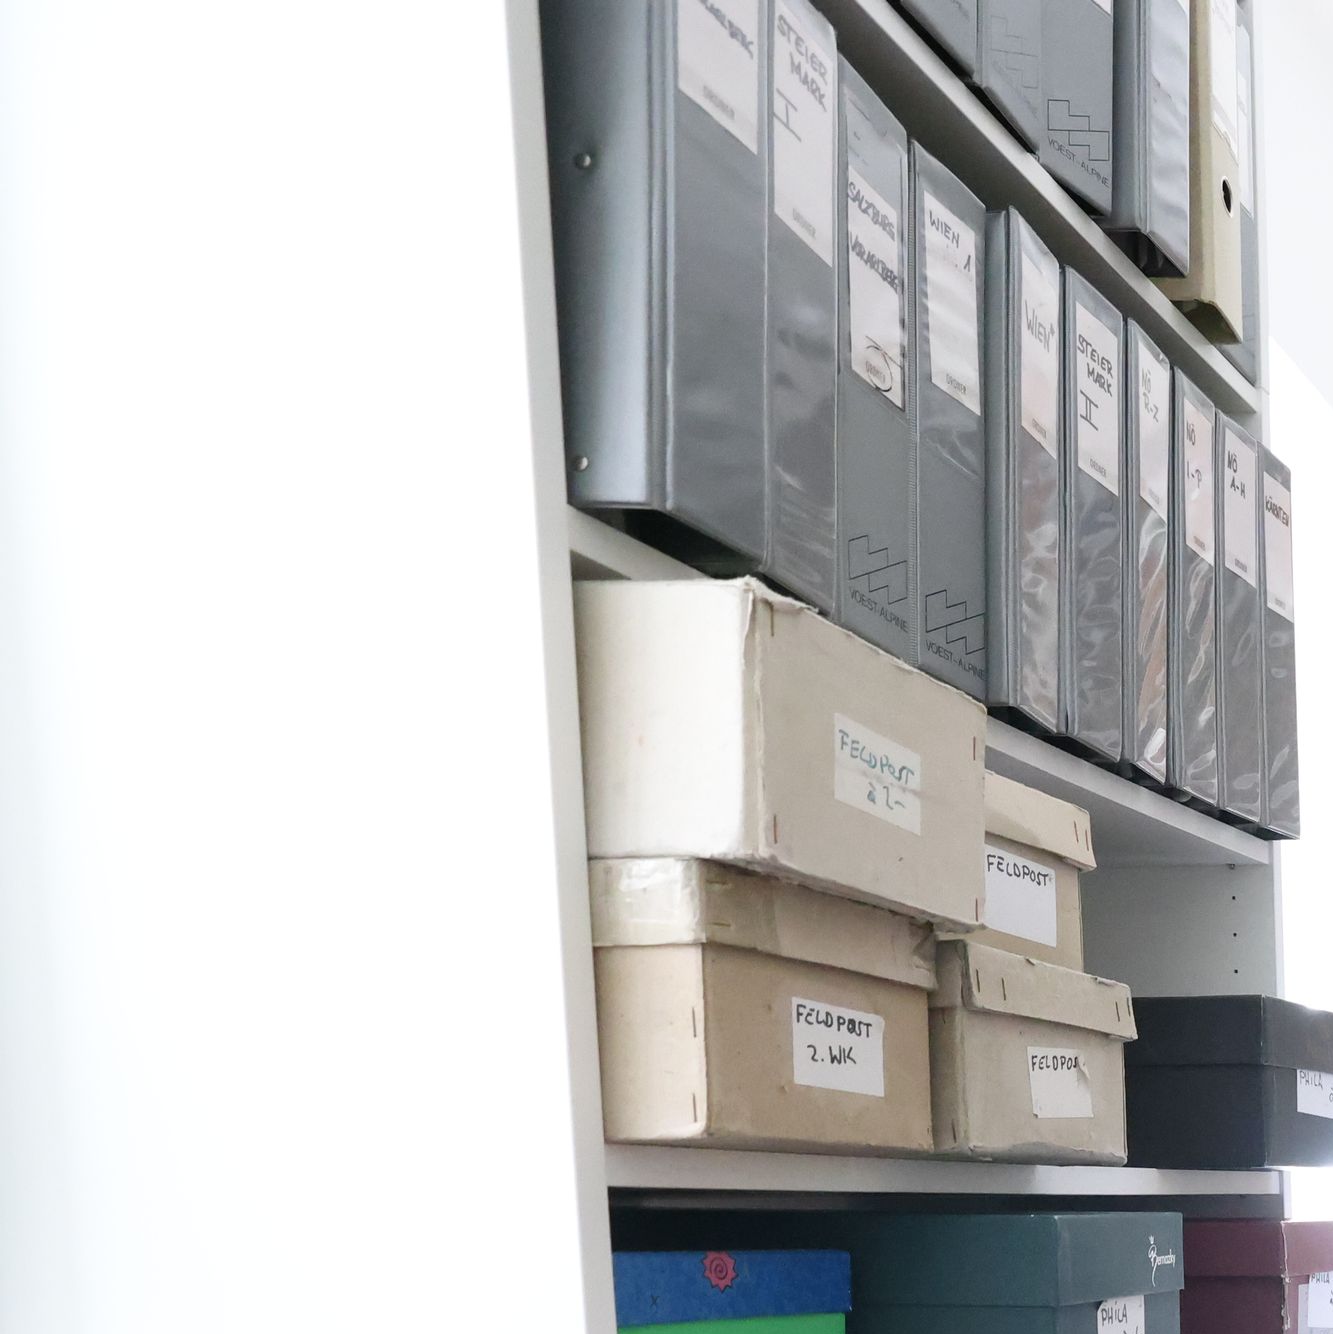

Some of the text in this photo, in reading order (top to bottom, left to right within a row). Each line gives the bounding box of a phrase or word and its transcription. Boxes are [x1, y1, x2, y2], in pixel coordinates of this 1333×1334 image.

[777, 13, 828, 85] STEIER
[789, 51, 827, 112] MARK
[1047, 137, 1109, 188] VOEST-ALPINE
[929, 209, 960, 249] WIEN
[1077, 334, 1114, 379] STEIER
[1086, 362, 1113, 398] MARK
[1227, 450, 1238, 474] NÖ
[848, 585, 910, 634] VOEST-ALPINE
[925, 639, 985, 680] VOEST-ALPINE
[838, 728, 915, 785] FELDPOST
[986, 853, 1050, 887] FELDPOST
[795, 1003, 873, 1040] FELDPOST
